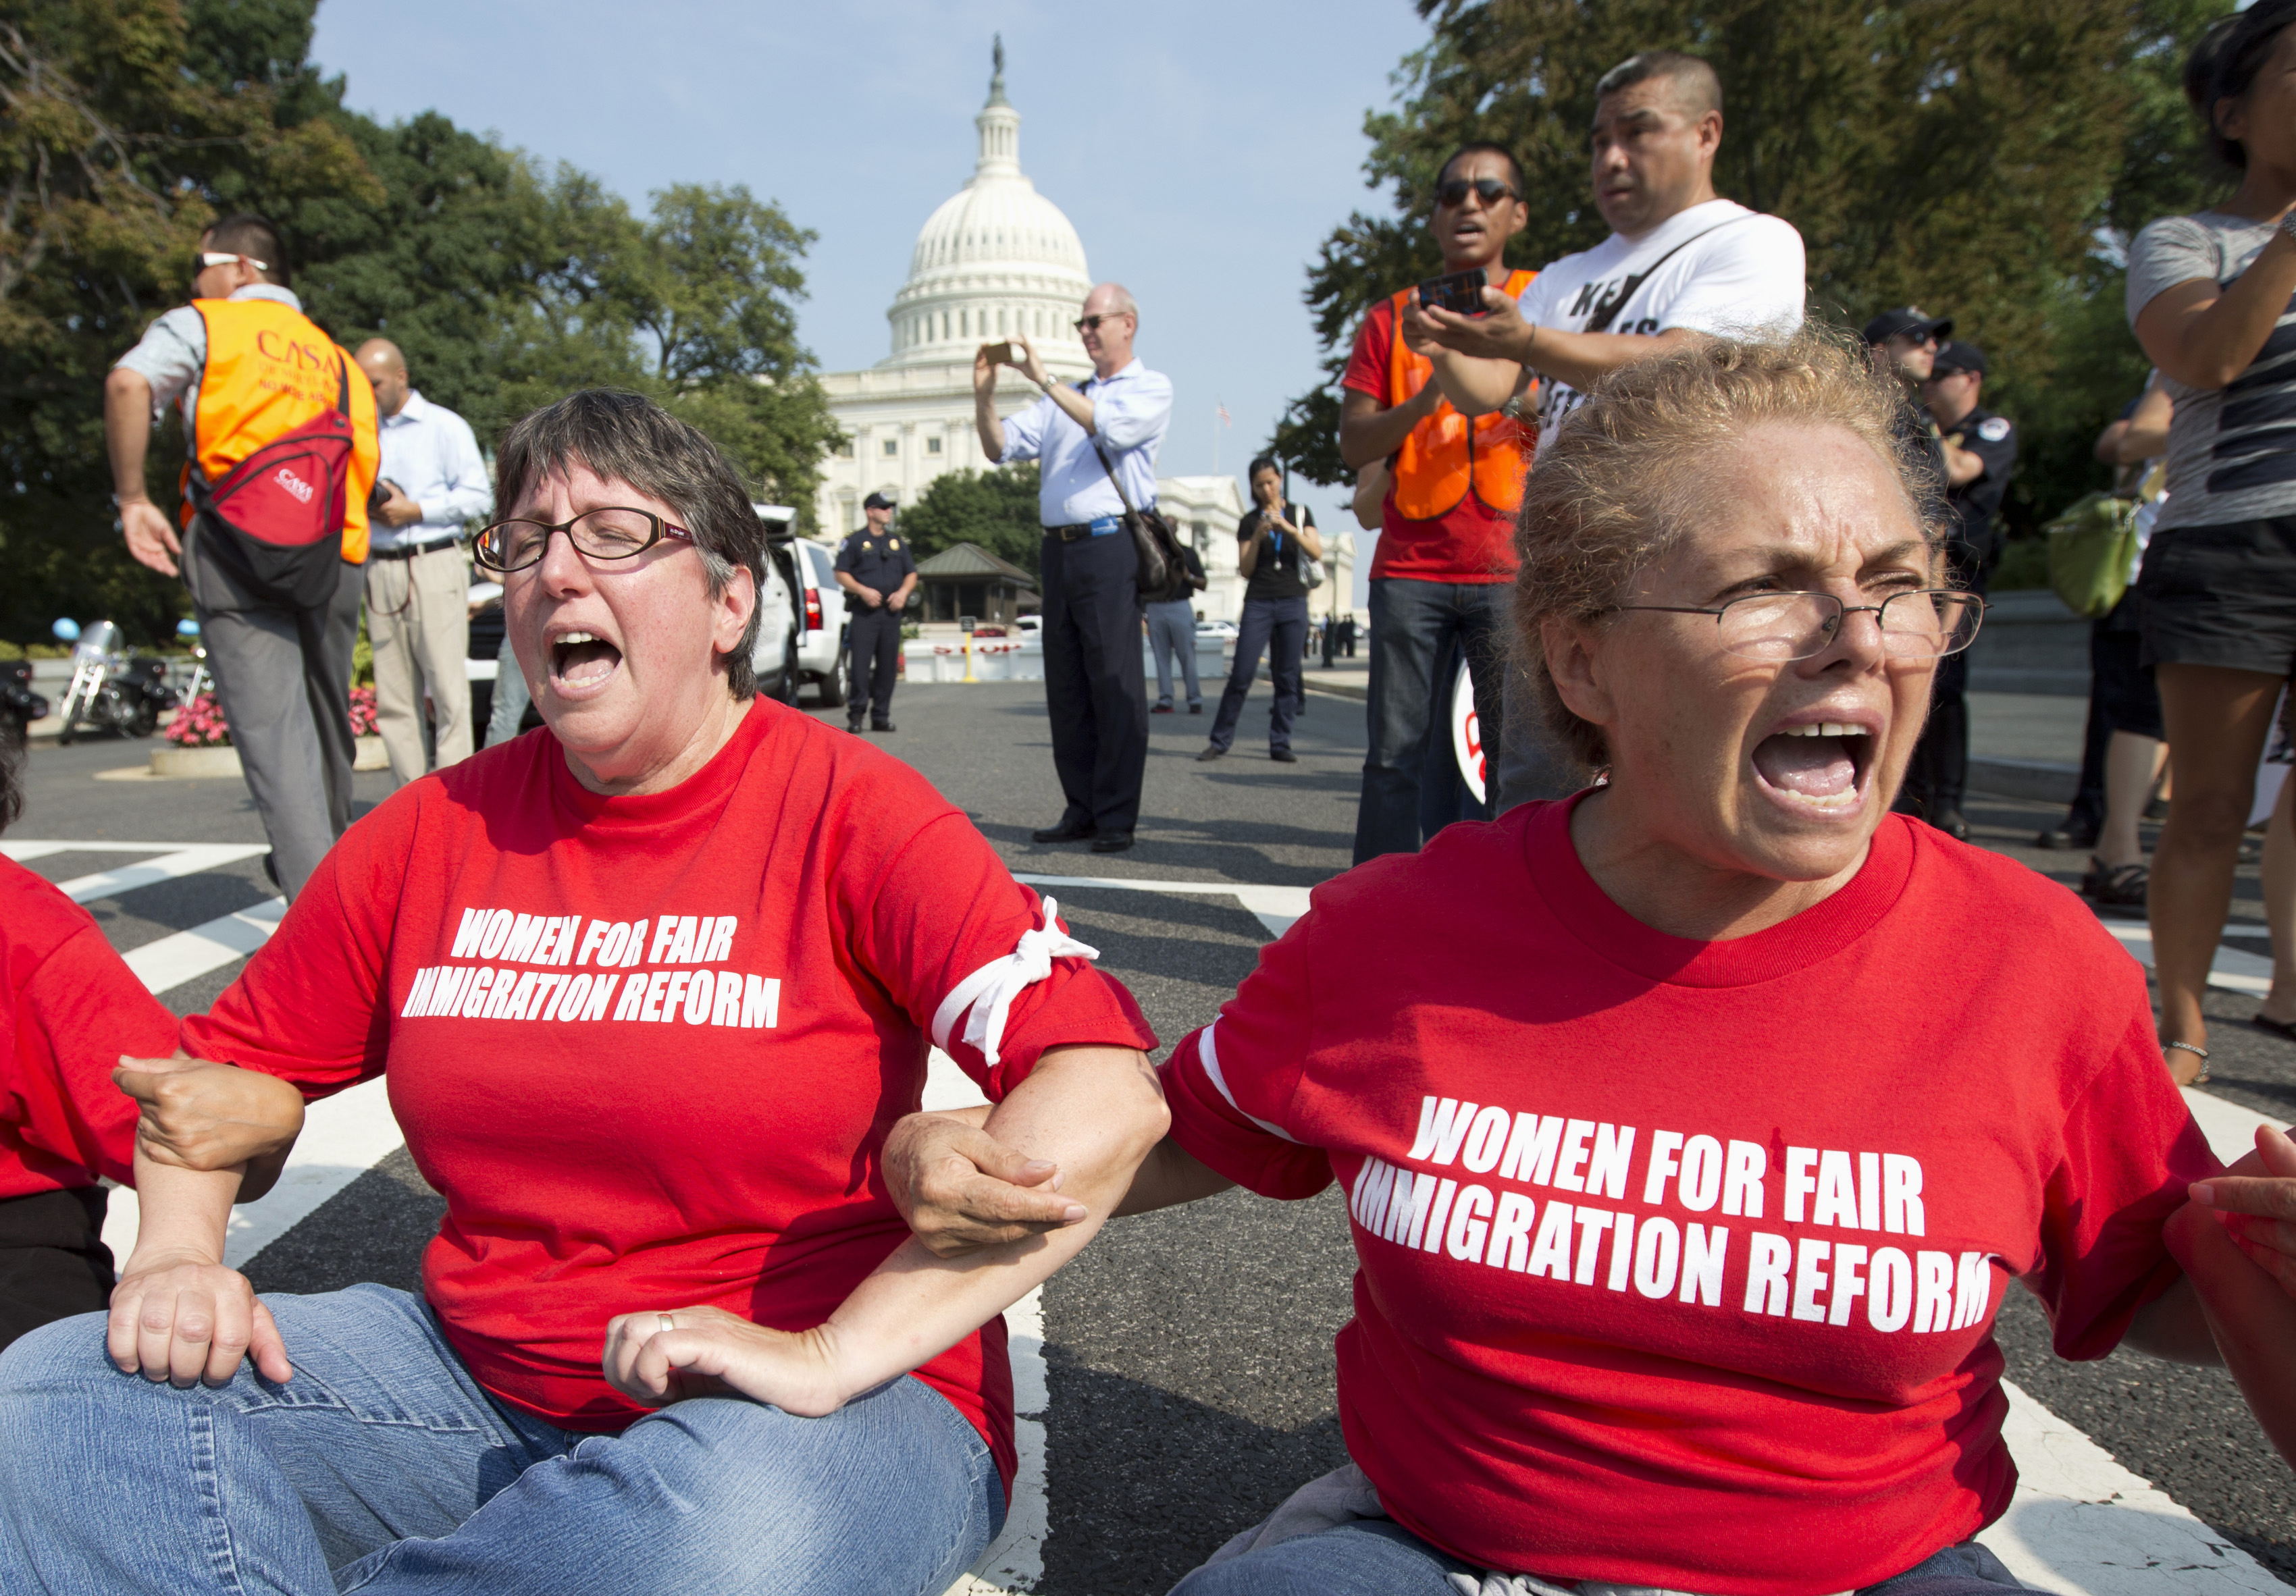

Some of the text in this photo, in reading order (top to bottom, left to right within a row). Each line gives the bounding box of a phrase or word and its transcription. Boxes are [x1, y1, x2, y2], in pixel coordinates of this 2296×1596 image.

[256, 329, 340, 382] CASA
[259, 378, 277, 391] NO
[279, 469, 314, 500] CASA
[450, 907, 738, 968] WOMEN FOR FAIR
[400, 965, 781, 1028] IMMIGRATION REFORM
[1407, 1095, 1926, 1237] WOMEN FOR FAIR
[1351, 1155, 1992, 1334] IMMIGRATION REFORM
